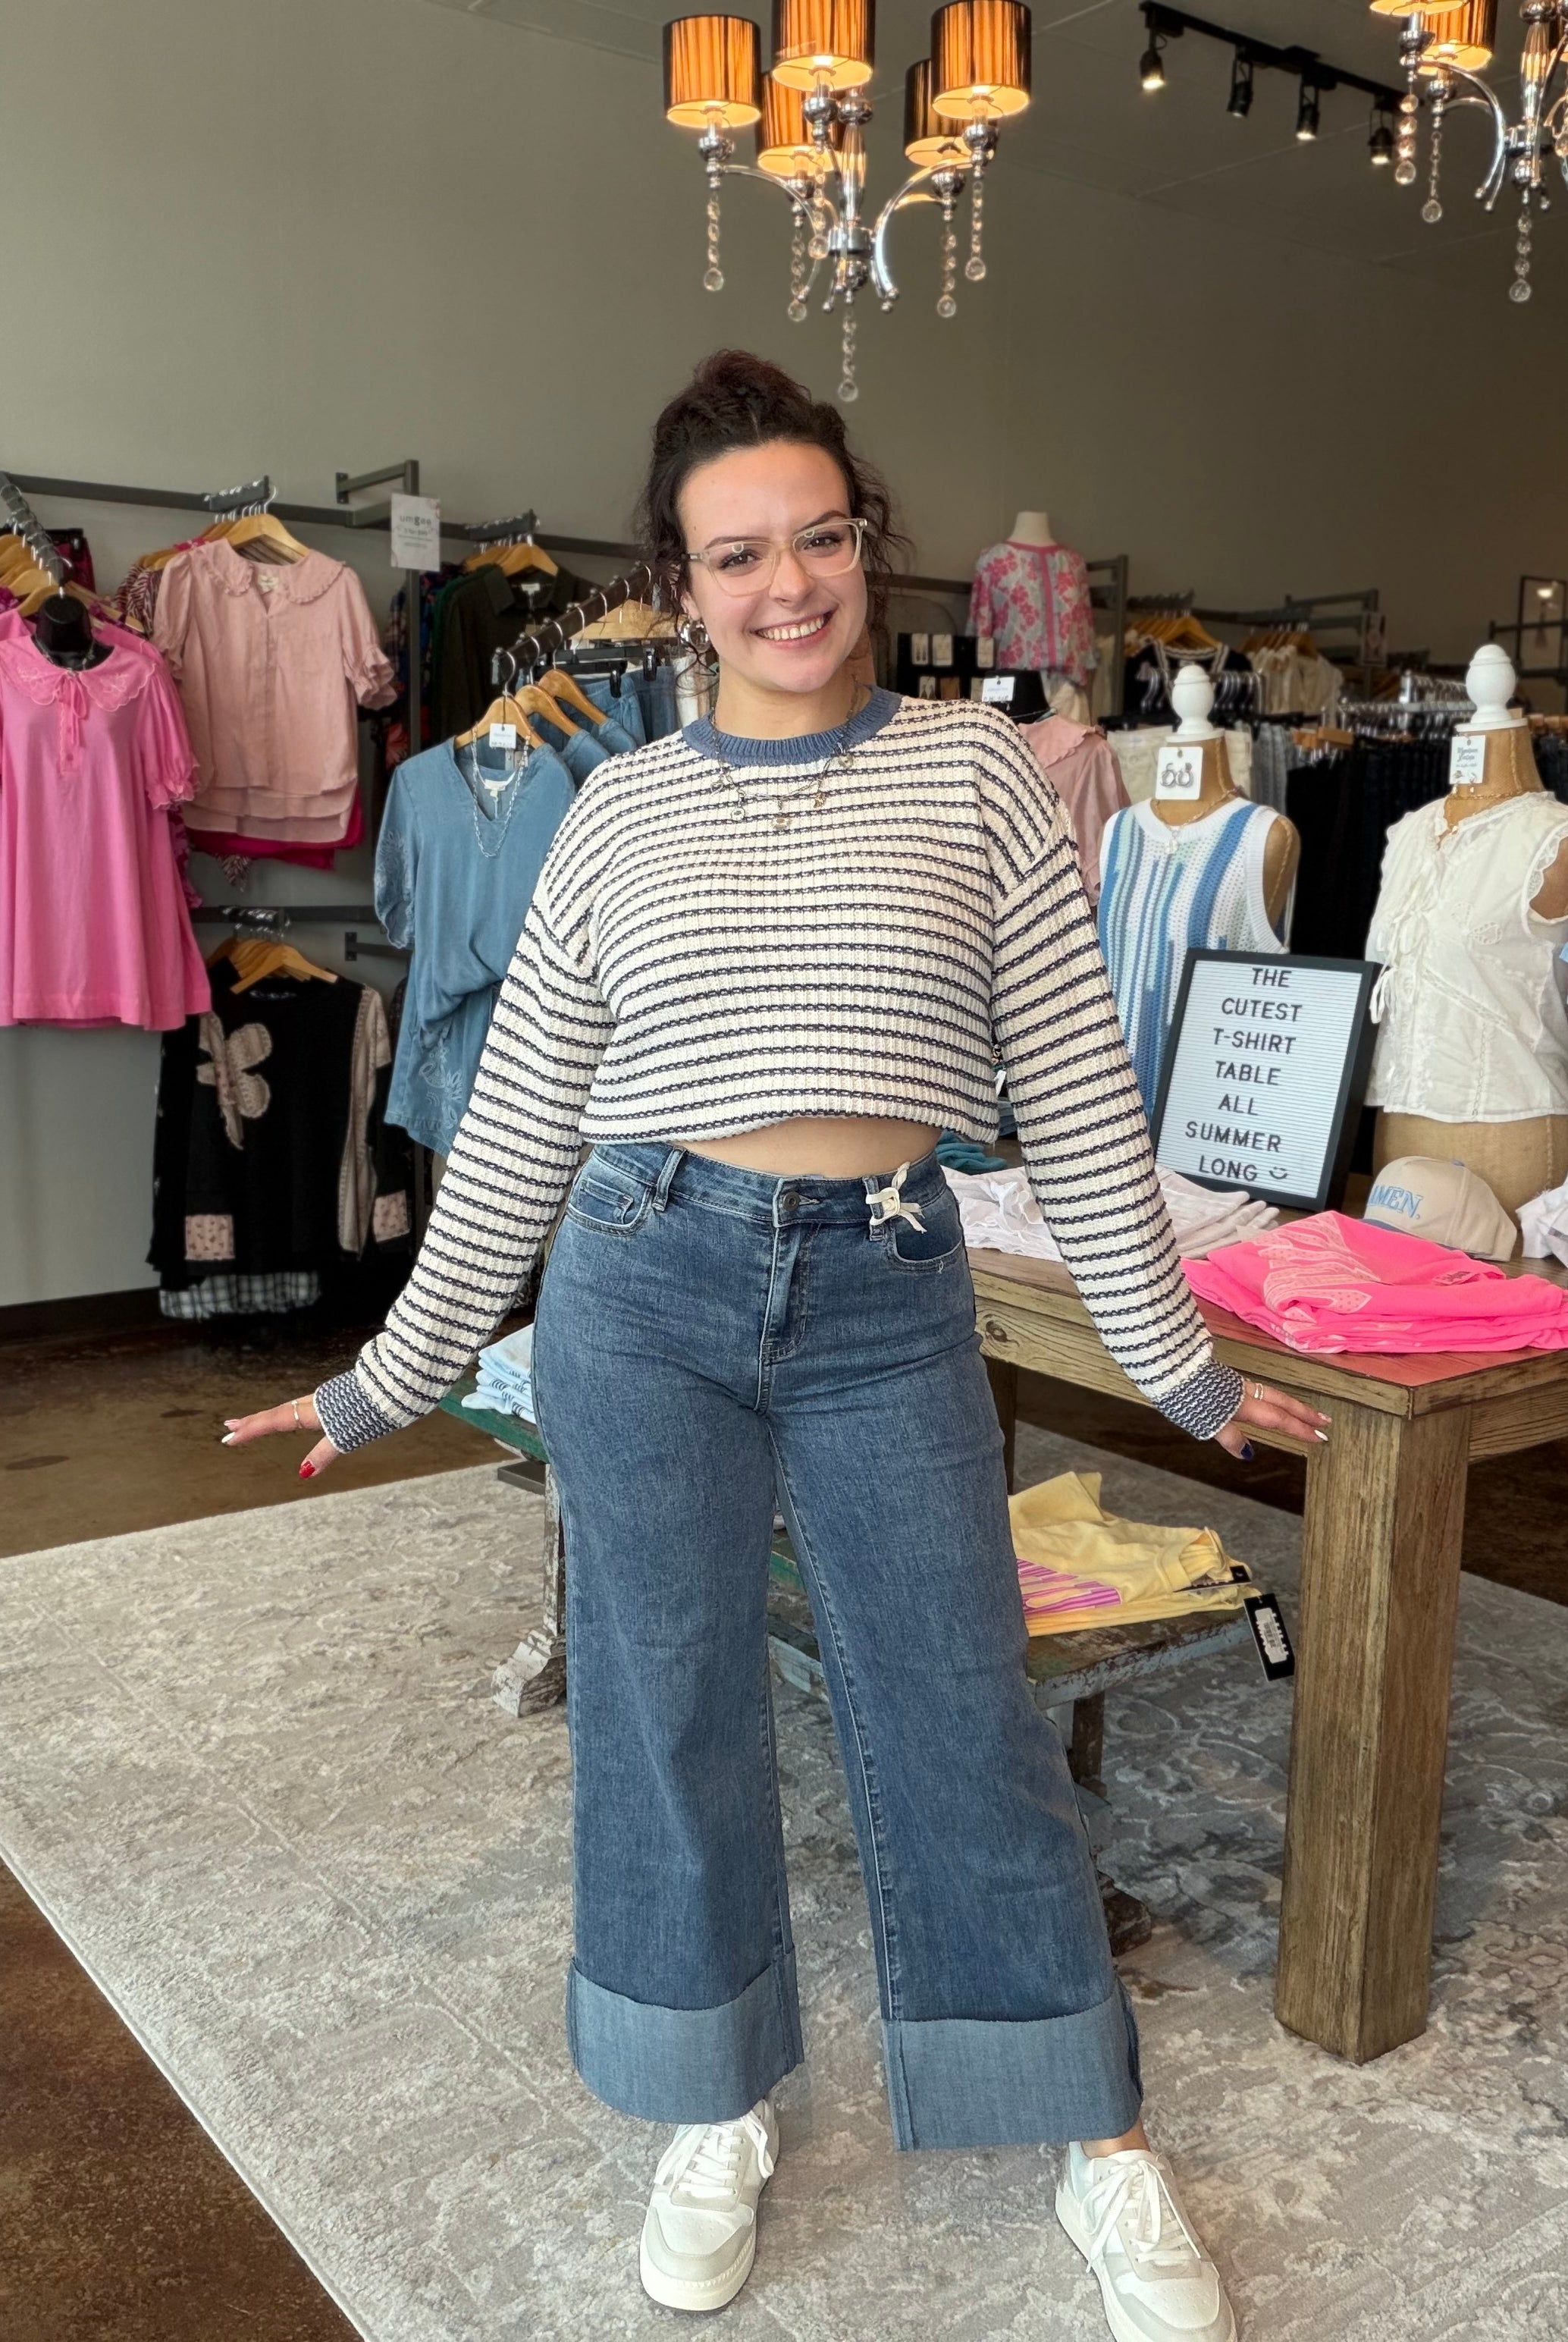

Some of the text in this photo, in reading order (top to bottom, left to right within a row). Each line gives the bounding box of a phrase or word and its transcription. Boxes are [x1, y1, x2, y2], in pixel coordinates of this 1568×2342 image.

[1252, 968, 1292, 987] THE
[1221, 997, 1303, 1022] CUTEST
[1213, 1028, 1297, 1054] T-SHIRT
[1215, 1060, 1281, 1085] TABLE
[1218, 1094, 1259, 1116] ALL
[1185, 1121, 1281, 1153] SUMMER
[1199, 1155, 1258, 1182] LONG
